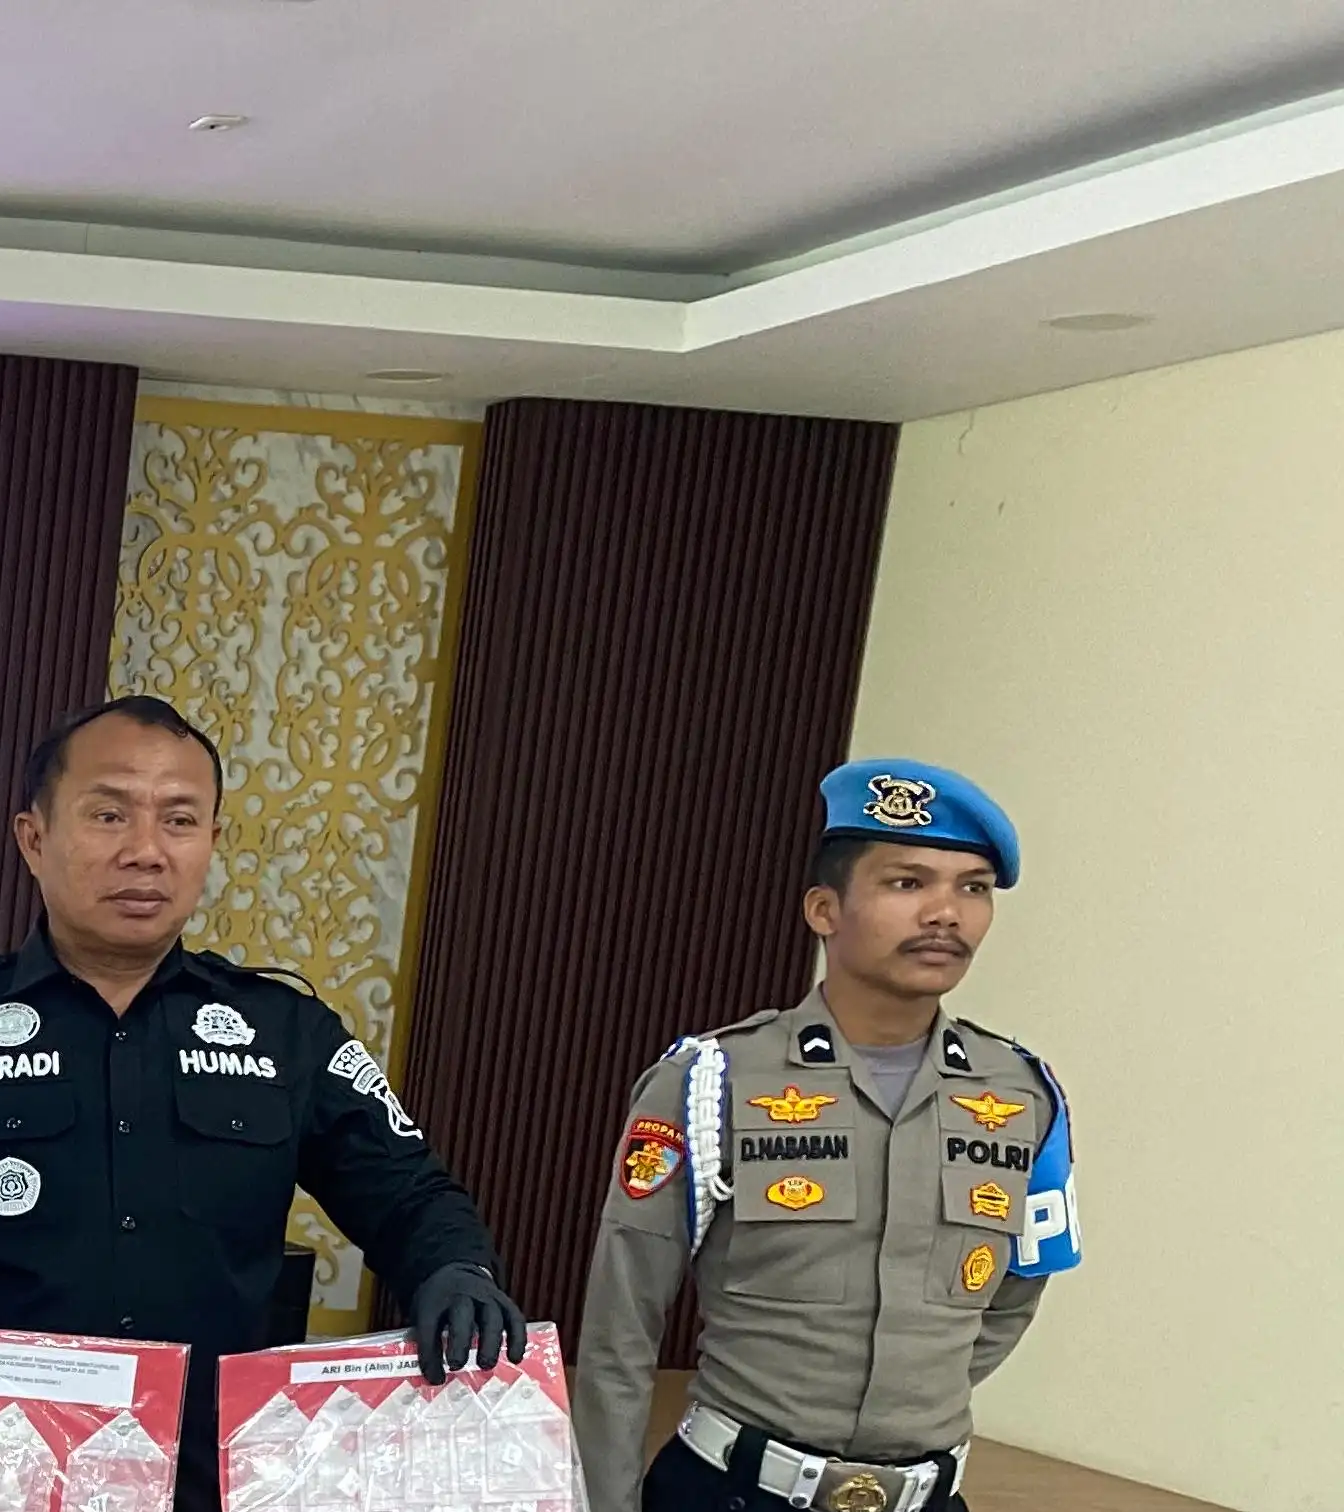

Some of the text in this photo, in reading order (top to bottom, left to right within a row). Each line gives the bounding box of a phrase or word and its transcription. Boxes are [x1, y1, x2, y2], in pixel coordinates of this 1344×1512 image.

[178, 1049, 277, 1079] HUMAS
[947, 1137, 1030, 1173] POLRI
[321, 1365, 341, 1375] ARI
[344, 1364, 362, 1373] Bin
[396, 1359, 419, 1371] JAB
